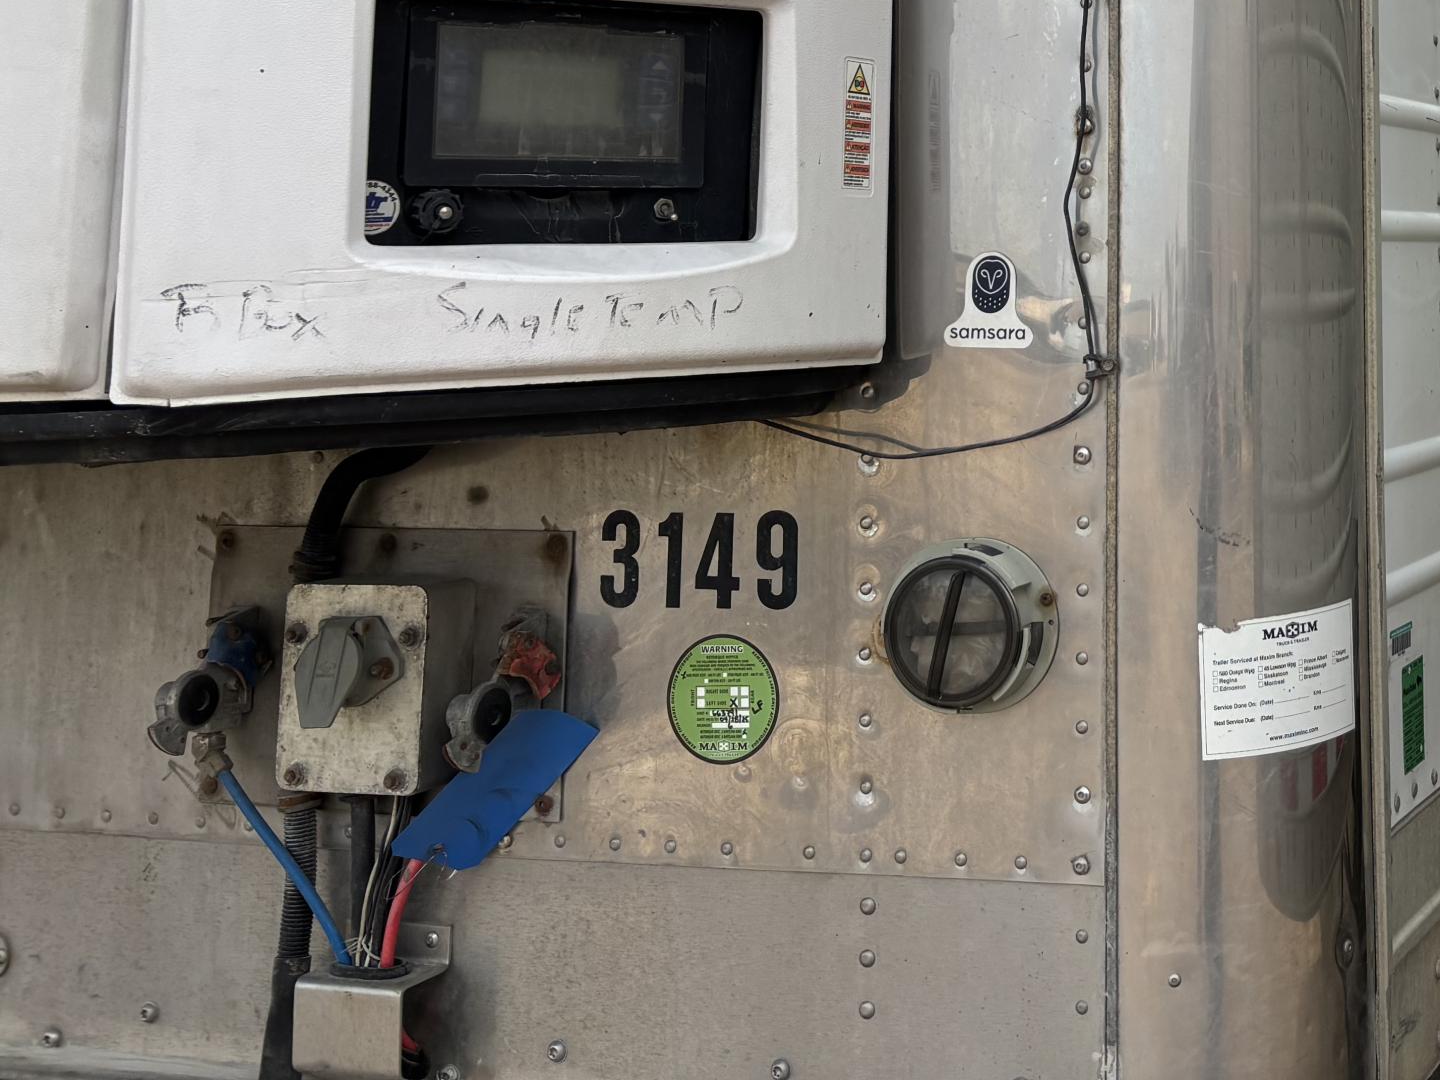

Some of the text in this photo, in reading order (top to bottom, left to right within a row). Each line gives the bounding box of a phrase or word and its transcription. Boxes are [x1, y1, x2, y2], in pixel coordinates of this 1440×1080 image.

[950, 327, 1026, 340] samsara
[600, 510, 799, 610] 3149
[1262, 620, 1319, 640] MAXIM
[701, 645, 743, 653] WARNING
[699, 740, 748, 752] MAXIM
